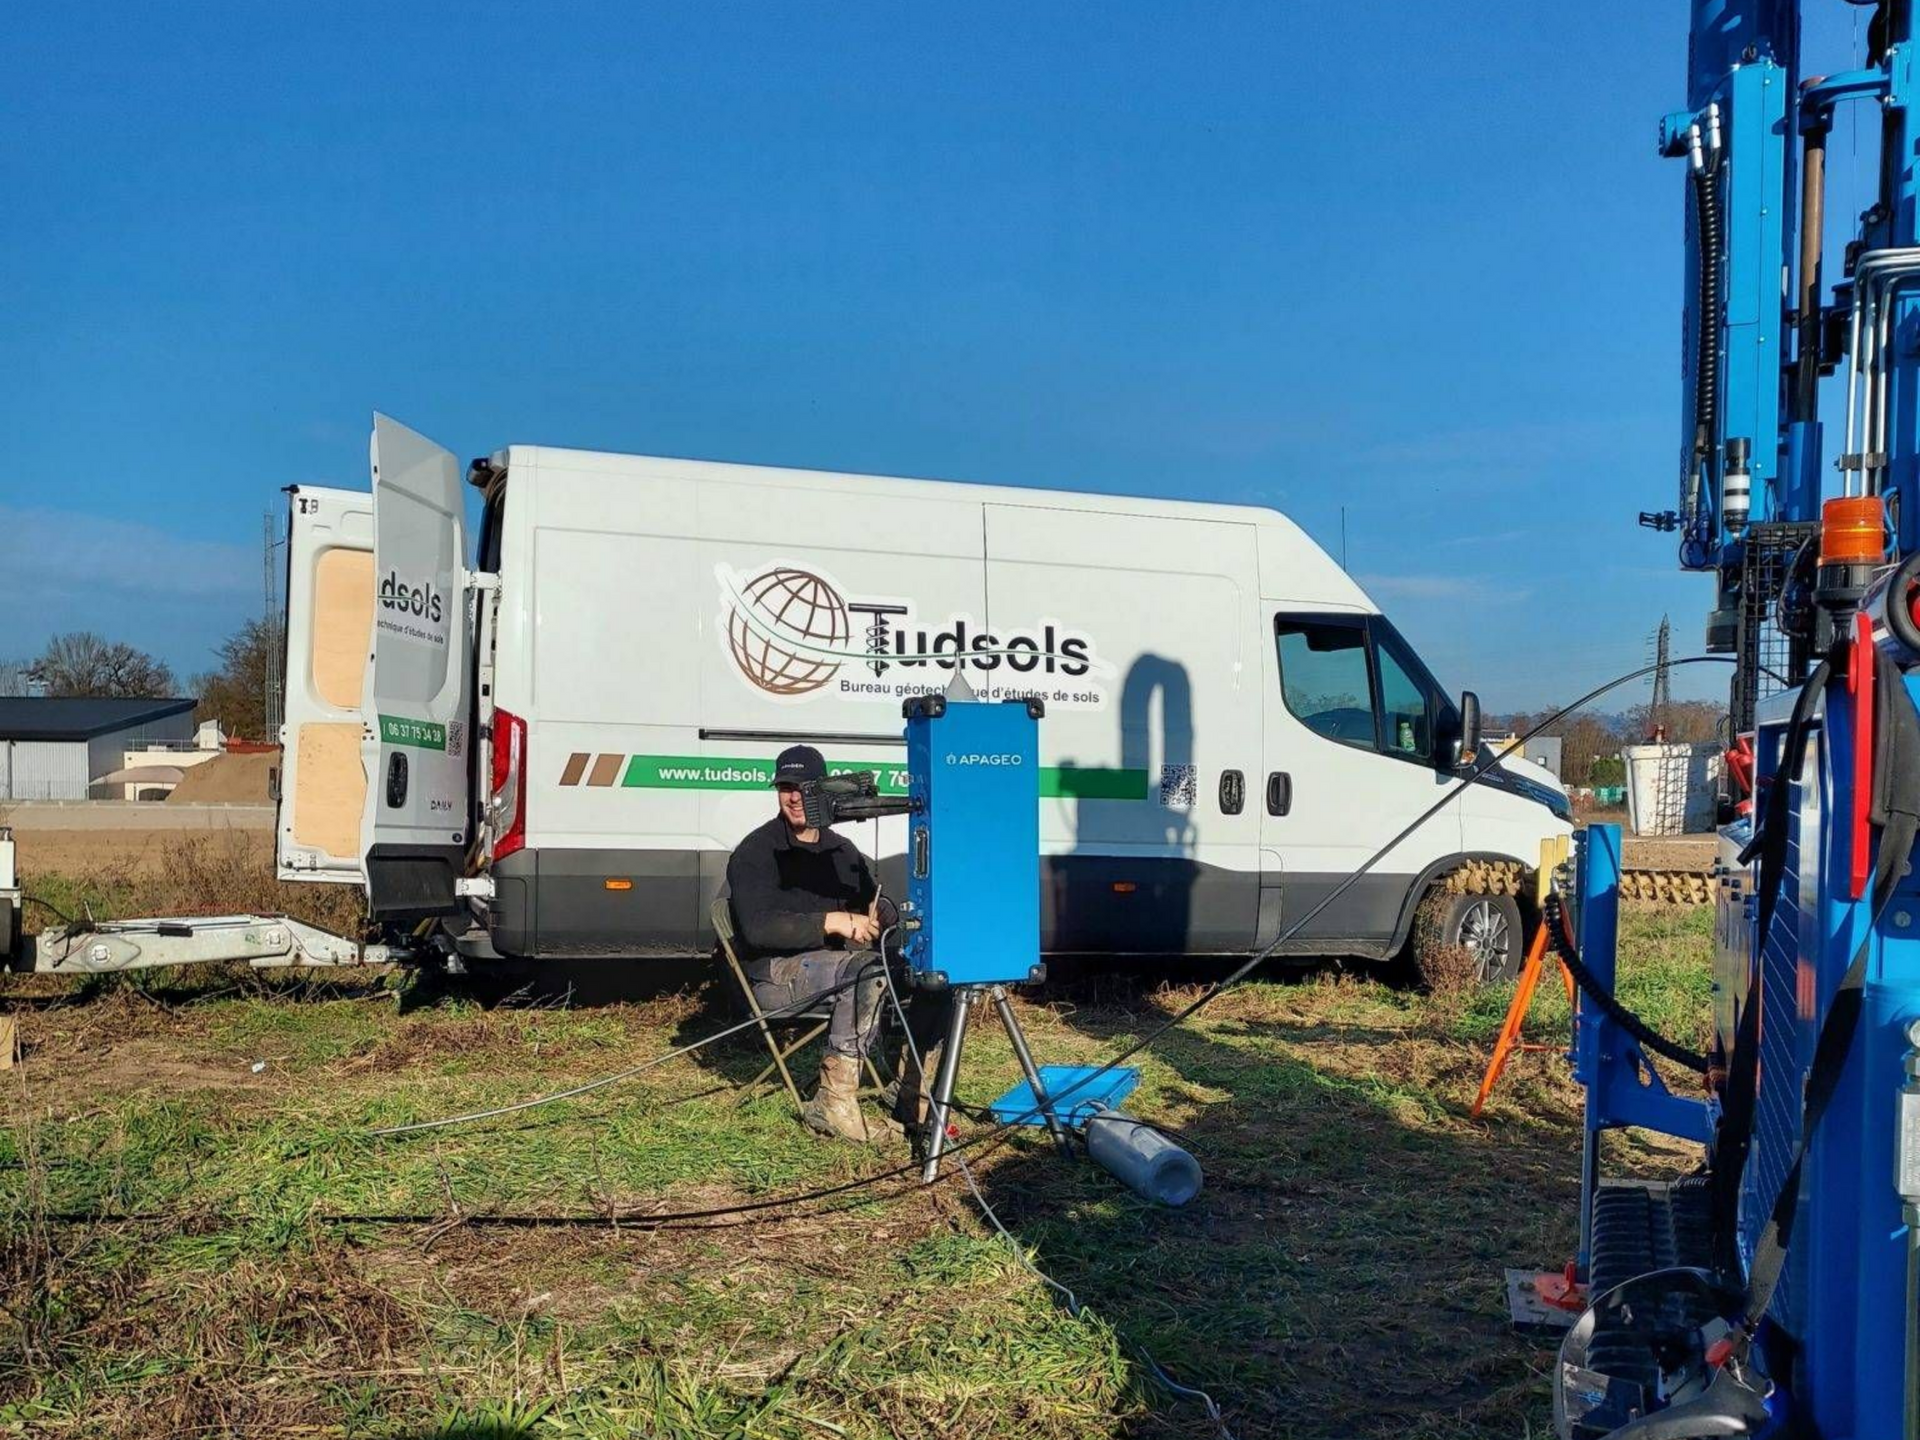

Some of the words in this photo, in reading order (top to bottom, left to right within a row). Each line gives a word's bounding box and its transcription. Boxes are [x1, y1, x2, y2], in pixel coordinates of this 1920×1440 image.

[379, 571, 441, 622] dsols
[848, 603, 1090, 678] Tudsols
[840, 680, 890, 693] Bureau
[992, 687, 1049, 700] d'études
[1053, 689, 1069, 701] de
[1073, 691, 1099, 703] sols
[388, 722, 399, 736] 06
[400, 724, 410, 738] 37
[411, 726, 421, 740] 75
[959, 754, 1022, 765] APAGEO
